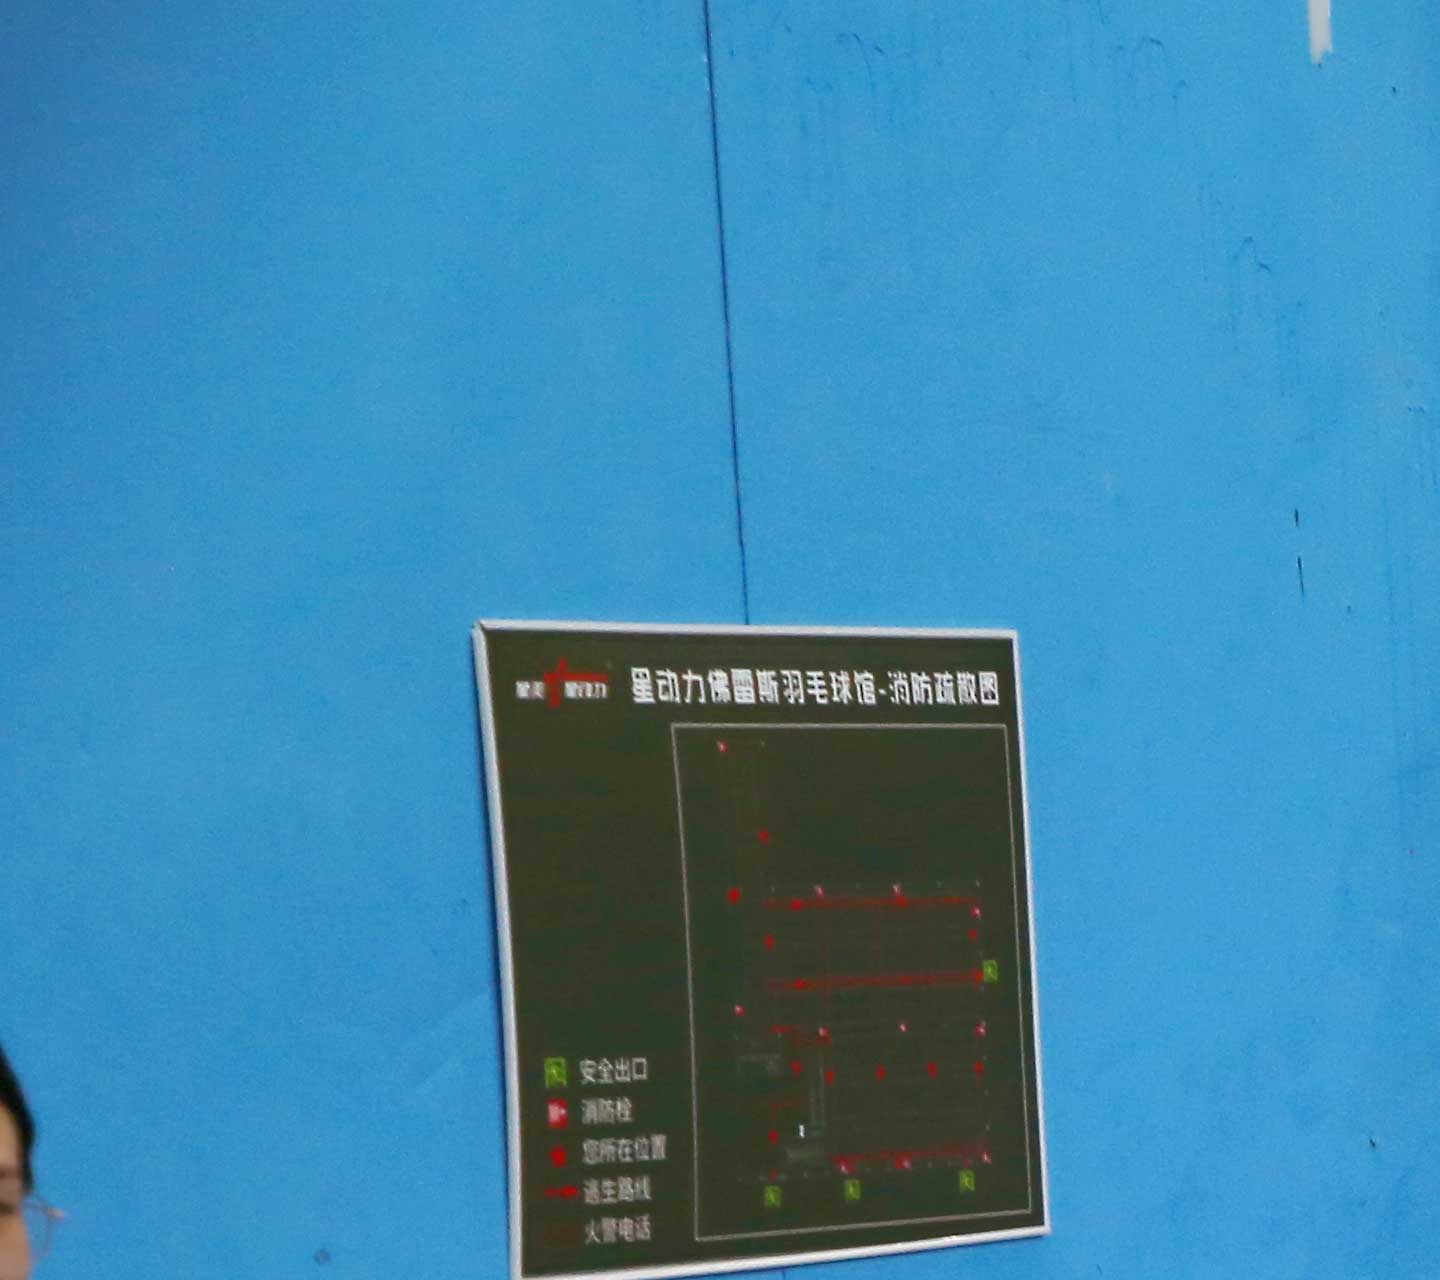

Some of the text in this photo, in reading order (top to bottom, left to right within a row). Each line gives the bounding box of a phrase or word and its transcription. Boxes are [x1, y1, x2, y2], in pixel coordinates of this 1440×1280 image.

[579, 1058, 648, 1085] 安全出口
[581, 1097, 633, 1125] 消防栓
[582, 1134, 667, 1165] 您所在位置
[585, 1214, 652, 1247] 火警电话
